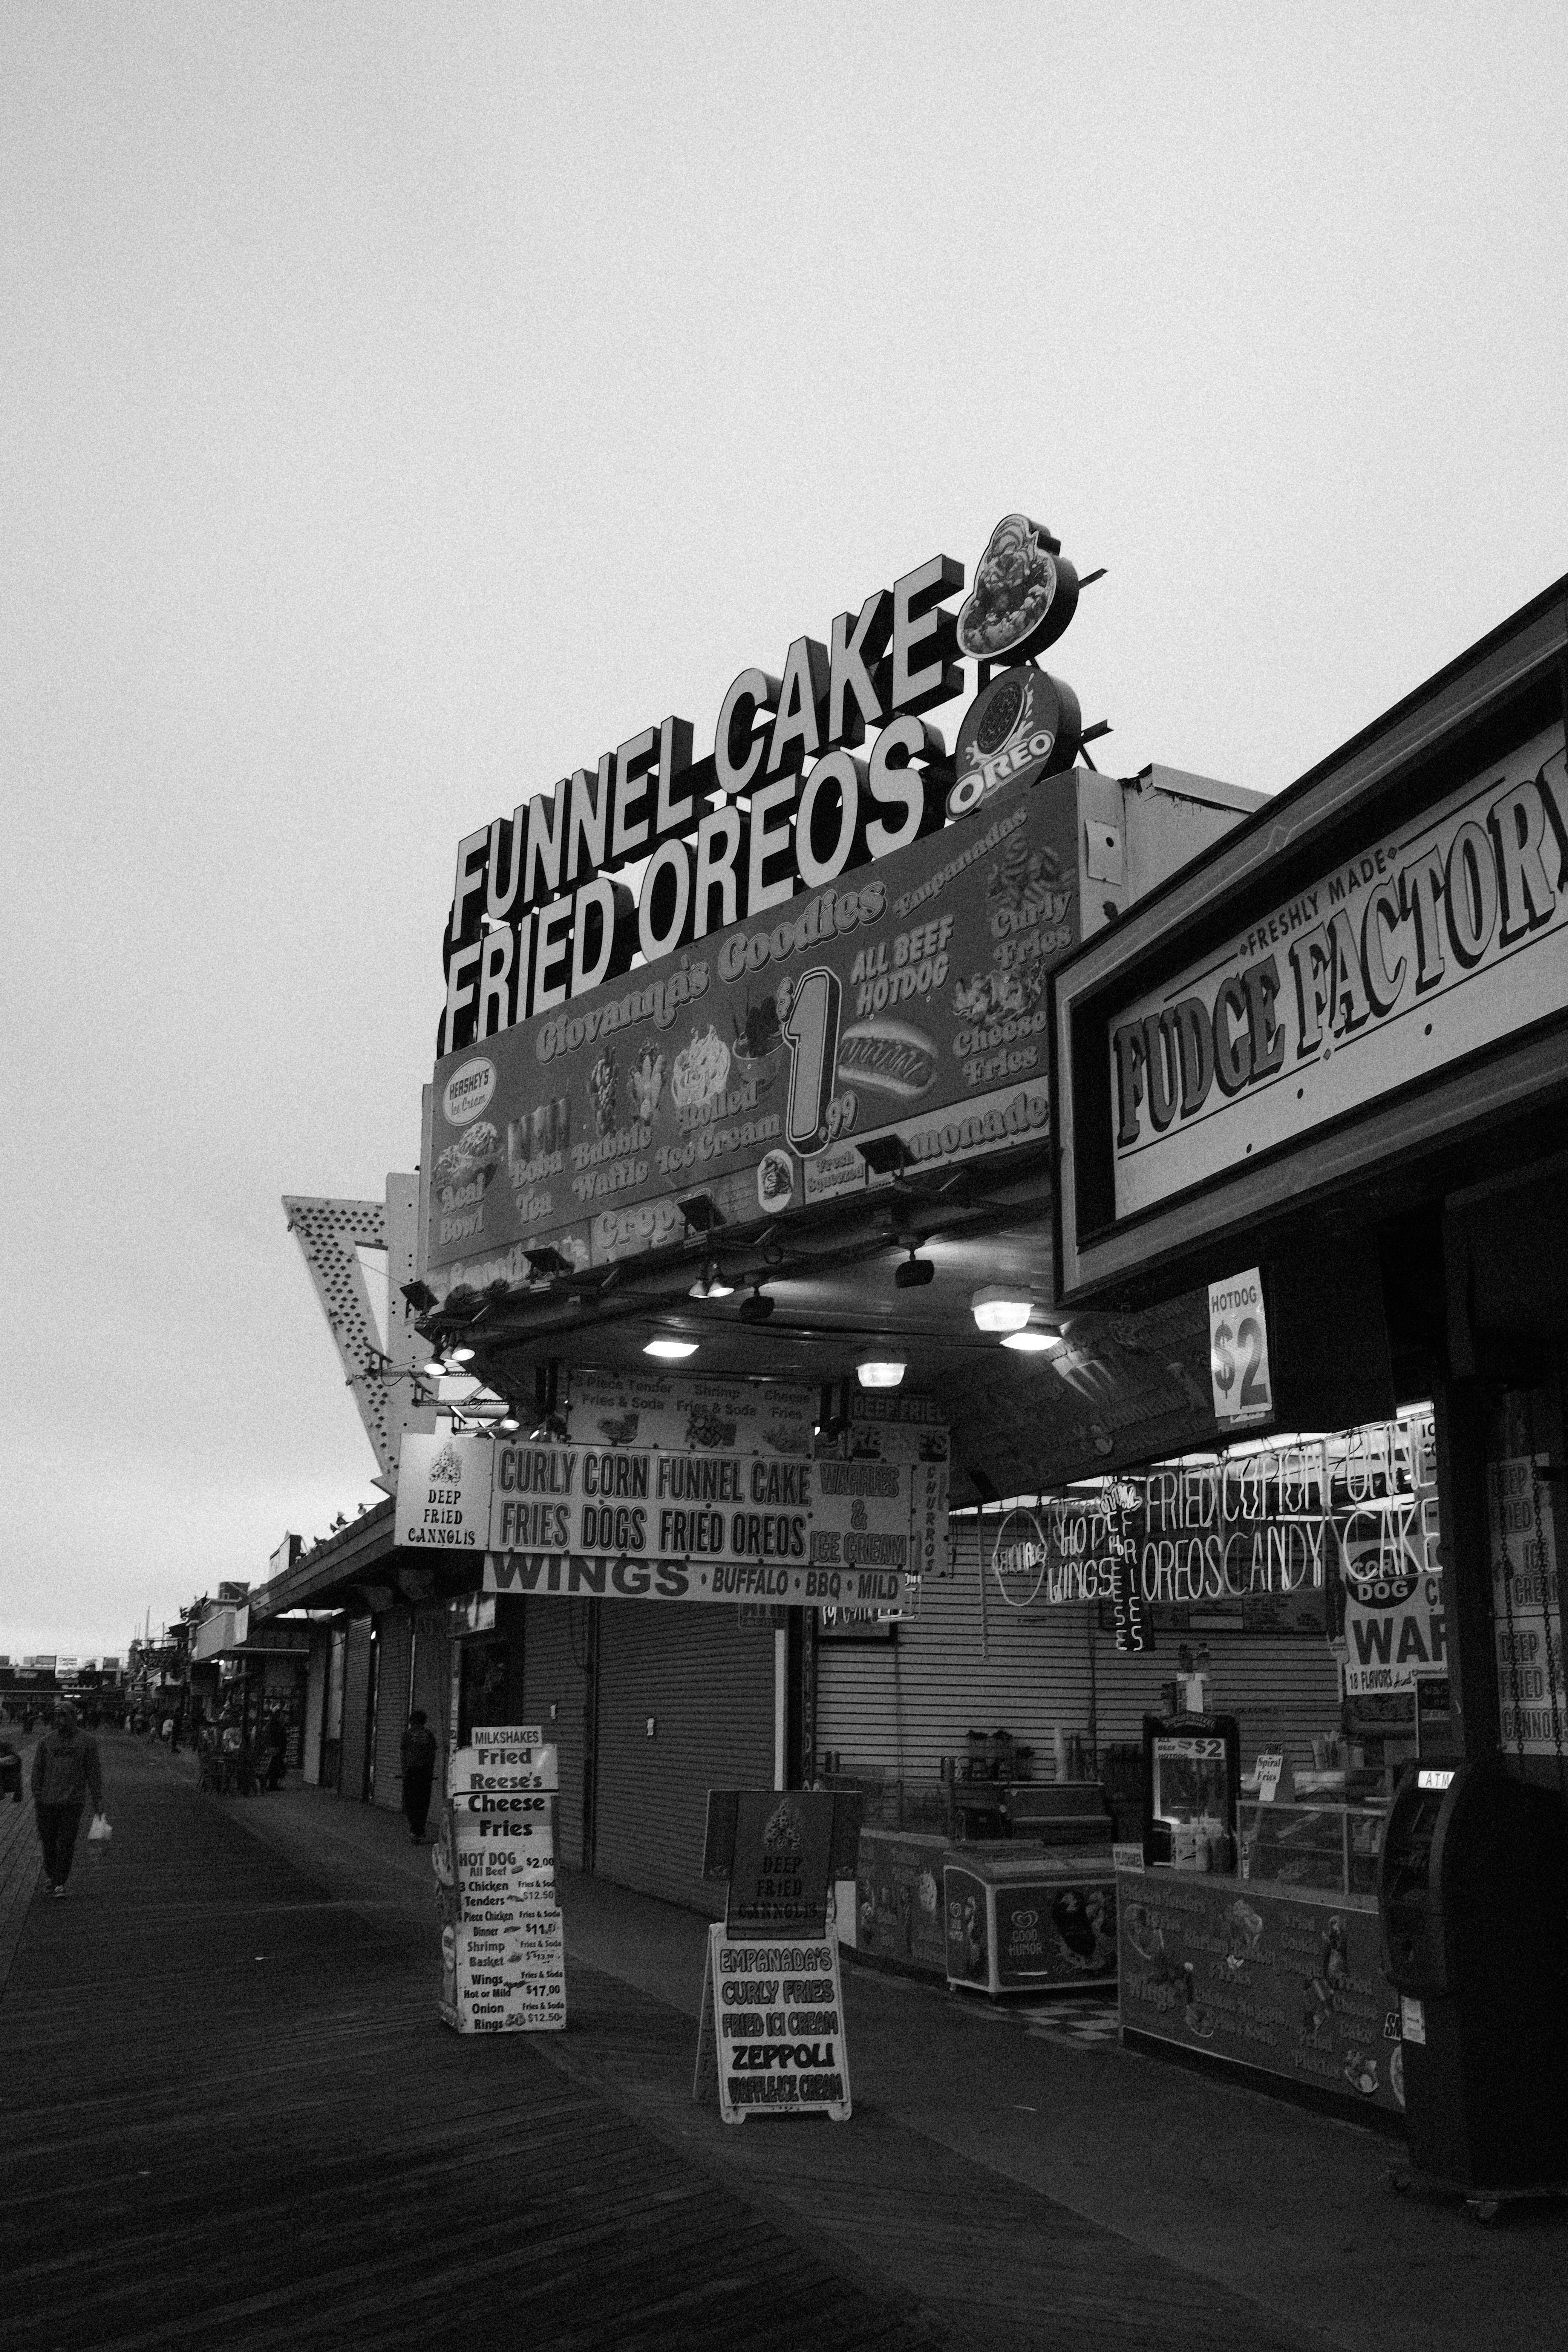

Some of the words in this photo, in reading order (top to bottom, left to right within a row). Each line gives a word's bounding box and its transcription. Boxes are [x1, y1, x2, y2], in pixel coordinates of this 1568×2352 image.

[451, 715, 693, 941] FUNNEL
[715, 553, 950, 794] CAKE
[949, 733, 1052, 814] OREO
[893, 806, 1028, 919] Empanadas
[445, 876, 622, 1057] FRIED
[639, 714, 925, 963] OREOS
[991, 892, 1072, 939] Curly
[1247, 894, 1320, 956] FRESHLY
[1328, 858, 1388, 906] MADE
[851, 942, 889, 985] ALL
[894, 914, 956, 969] BEEF
[994, 926, 1072, 970] Fries
[536, 962, 710, 1064] Giovanna's
[718, 882, 886, 983] Goodies
[857, 952, 950, 1016] HOTDOG
[952, 1011, 1047, 1057] Cheese
[1113, 953, 1285, 1148] FUDGE
[962, 1046, 1039, 1087] Fries
[450, 1068, 490, 1101] HERSHEY'S
[462, 1094, 486, 1112] Cream
[679, 1078, 758, 1133] Rolled
[571, 1124, 652, 1171] Bubble
[657, 1144, 695, 1176] Ice
[698, 1113, 782, 1163] Cream
[508, 1151, 564, 1190] Boba
[816, 1150, 854, 1173] Fresh
[572, 1158, 649, 1204] Waffle
[808, 1162, 864, 1193] Squeezed
[516, 1192, 553, 1224] Tea
[441, 1207, 485, 1246] Bowl
[1211, 1286, 1257, 1314] HOTDOG
[1214, 1317, 1268, 1410] $2
[587, 1376, 623, 1391] Piece
[627, 1379, 673, 1394] Tender
[694, 1384, 740, 1400] Shrimp
[765, 1389, 810, 1404] Cheese
[582, 1395, 614, 1407] Fries
[619, 1396, 628, 1407] &
[632, 1398, 664, 1410] Soda
[677, 1400, 707, 1414] Fries
[725, 1403, 757, 1417] Soda
[771, 1406, 802, 1420] Fries
[853, 1396, 896, 1418] DEEP
[499, 1448, 579, 1495] CURLY
[582, 1451, 649, 1499] CORN
[656, 1455, 745, 1504] FUNNEL
[751, 1460, 812, 1507] CAKE
[820, 1463, 900, 1498] WAFFLES
[427, 1489, 462, 1506] DEEP
[1146, 1465, 1216, 1533] FRIED
[851, 1499, 867, 1530] &
[924, 1465, 936, 1573] CHURROS
[501, 1502, 570, 1548] FRIES
[581, 1504, 646, 1552] DOGS
[658, 1508, 725, 1554] FRIED
[731, 1511, 807, 1558] OREOS
[810, 1530, 841, 1563] ICE
[843, 1533, 906, 1565] CREAM
[1142, 1534, 1223, 1601] OREOS
[1223, 1521, 1325, 1596] CANDY
[1343, 1497, 1443, 1580] CAKE
[492, 1554, 691, 1597] WINGS
[711, 1567, 788, 1596] BUFFALO
[805, 1571, 841, 1599] BBQ
[857, 1574, 899, 1600] MILD
[1049, 1557, 1114, 1603] WINGS
[1357, 1580, 1409, 1601] DOG
[1361, 1669, 1393, 1691] FLAVORS
[475, 1730, 539, 1744] MILKSHAKES
[1194, 1738, 1222, 1757] $2
[478, 1748, 531, 1765] Fried
[1257, 1756, 1281, 1769] Spiral
[470, 1772, 542, 1789] Reese's
[1257, 1770, 1277, 1781] Fries
[1426, 1772, 1450, 1787] ATM
[468, 1794, 545, 1812] Cheese
[480, 1819, 533, 1837] Fries
[458, 1852, 484, 1867] HOT
[489, 1851, 516, 1865] DOG
[526, 1857, 554, 1868] $2.00
[470, 1867, 482, 1877] All
[486, 1867, 507, 1876] Beef
[762, 1856, 803, 1874] DEEP
[459, 1882, 466, 1892] 3
[469, 1881, 509, 1892] Chicken
[465, 1895, 505, 1906] Tenders
[523, 1891, 554, 1900] $12.50
[464, 1912, 483, 1922] Piece
[485, 1911, 513, 1922] Chicken
[519, 1910, 534, 1919] Fries
[473, 1926, 498, 1937] Dinner
[1012, 1928, 1038, 1942] GOOD
[467, 1941, 505, 1953] Shrimp
[720, 1947, 833, 1972] EMPANADA'S
[1008, 1941, 1043, 1956] HUMOR
[469, 1956, 504, 1968] Basket
[464, 1989, 479, 1998] Hot
[492, 1988, 511, 1997] Mild
[526, 1984, 560, 1997] $17.00
[471, 1974, 504, 1986] Wings
[721, 1980, 779, 2005] CURLY
[782, 1979, 835, 2004] FRIES
[472, 2003, 504, 2014] Onion
[522, 2002, 538, 2011] Fries
[474, 2018, 504, 2031] Rings
[528, 2013, 560, 2023] $12.50
[722, 2012, 765, 2038] FRIED
[788, 2011, 839, 2036] CREAM
[732, 2043, 835, 2070] ZEPPOLI
[727, 2075, 777, 2104] WAFFLE
[776, 2075, 799, 2102] ICE
[799, 2073, 844, 2102] CREAM
